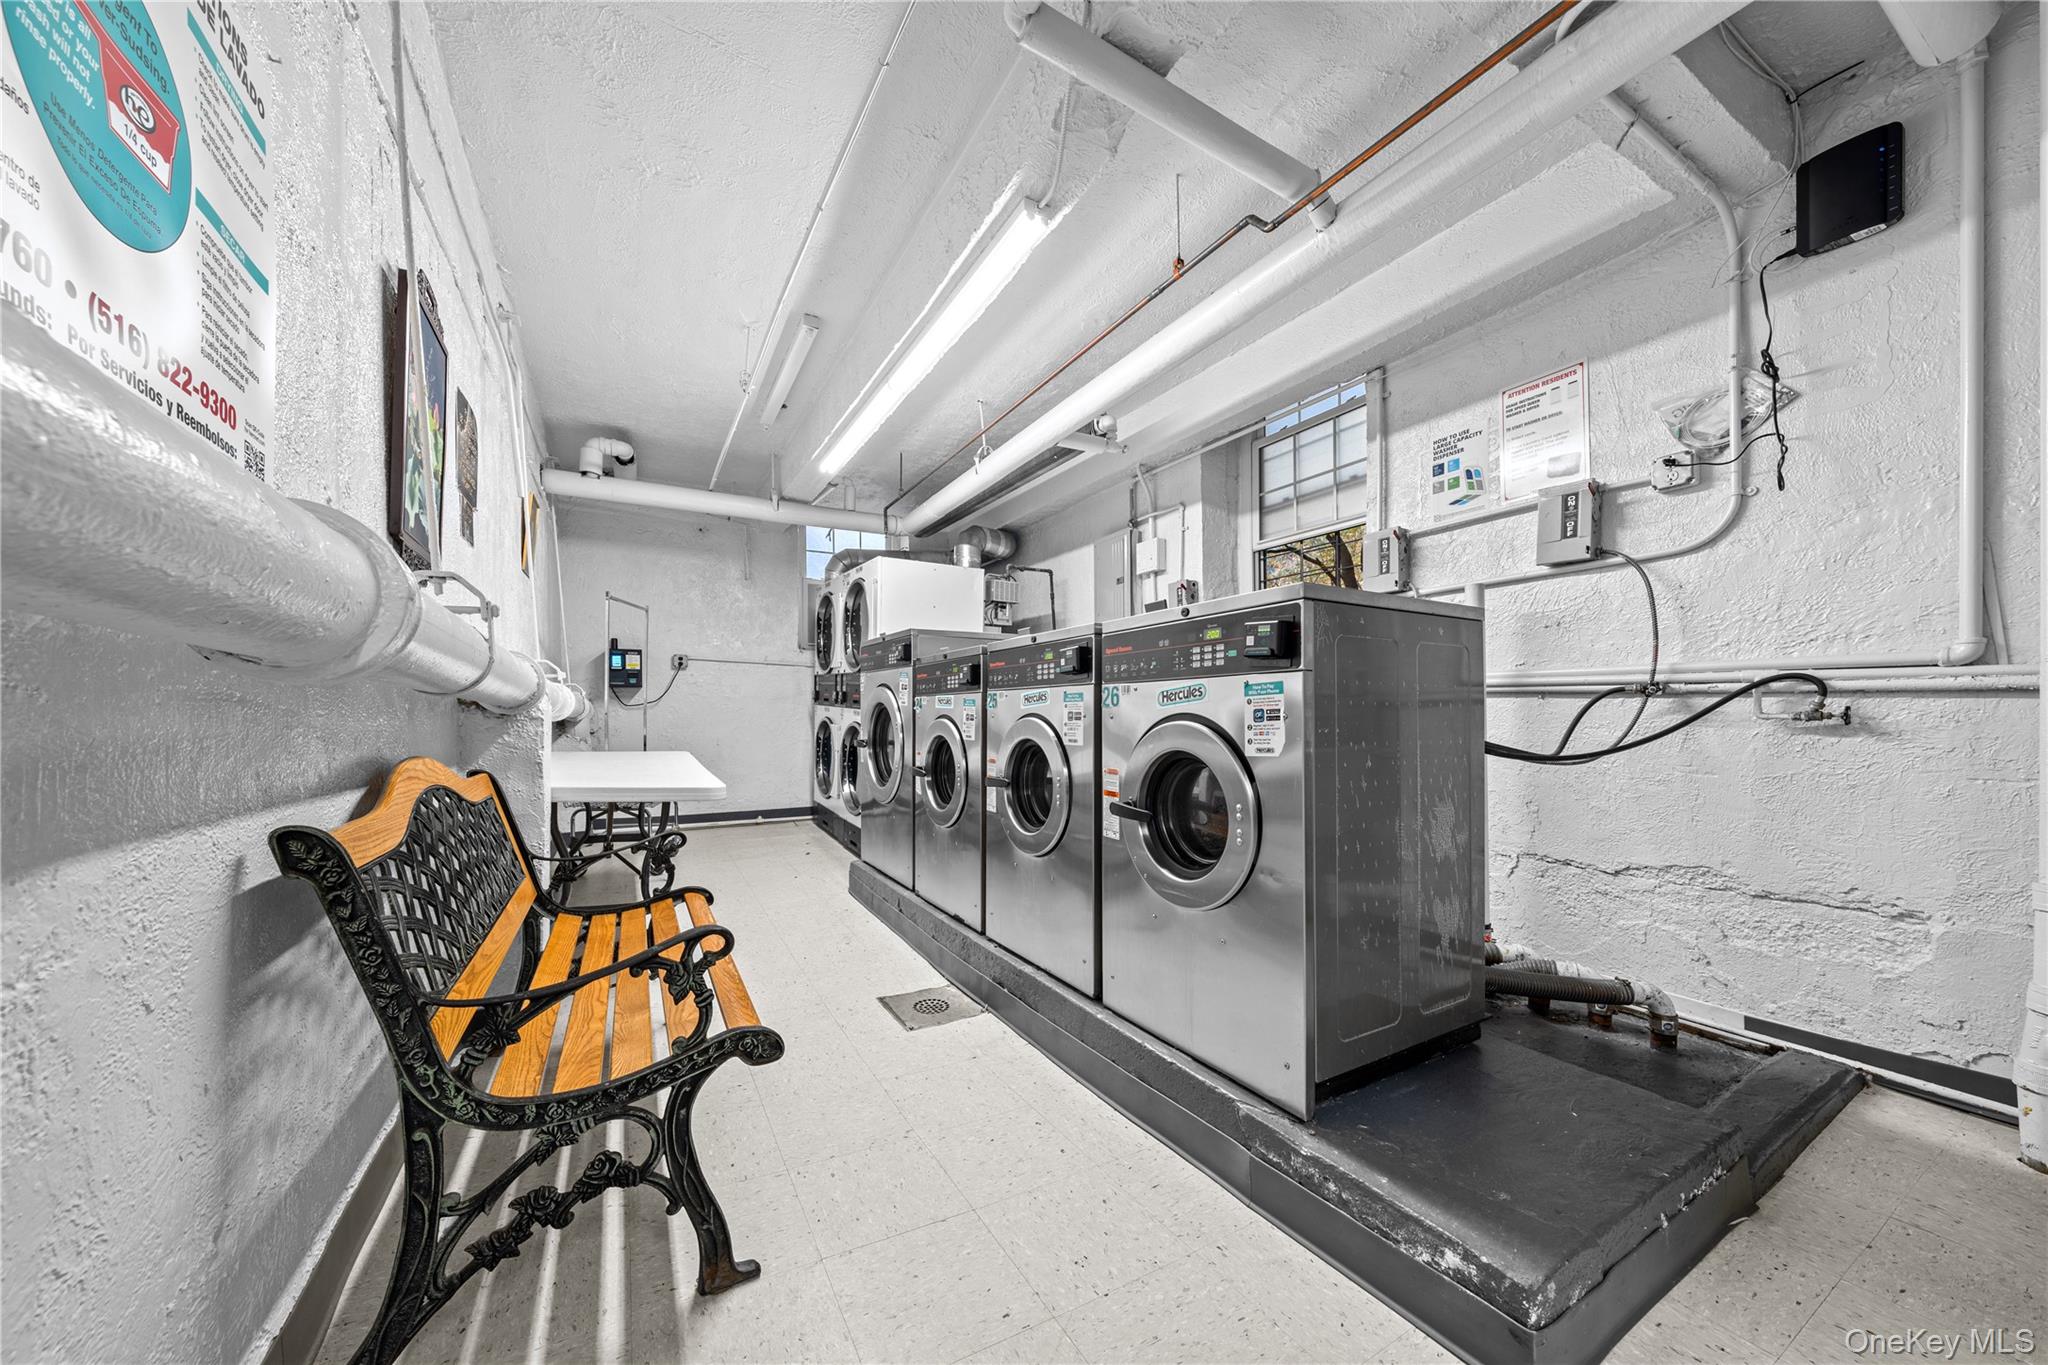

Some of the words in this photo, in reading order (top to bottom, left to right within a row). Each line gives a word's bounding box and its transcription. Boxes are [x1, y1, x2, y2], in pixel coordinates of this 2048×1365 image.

[65, 1, 76, 22] is
[77, 20, 92, 41] all
[15, 5, 48, 49] rinse
[48, 46, 96, 110] properly.
[52, 29, 71, 58] will
[72, 55, 91, 83] not
[62, 20, 74, 38] or
[75, 37, 100, 72] your
[144, 28, 157, 56] To
[220, 26, 265, 119] LAVADO
[50, 91, 67, 119] Use
[69, 115, 95, 152] Menos
[97, 147, 139, 198] Detergente
[140, 192, 158, 218] Para
[123, 123, 138, 147] 1/4
[140, 141, 157, 168] cup
[28, 175, 40, 194] de
[43, 101, 77, 146] Prevenir
[78, 143, 87, 159] El
[89, 156, 118, 191] Exceso
[120, 186, 131, 203] De
[133, 199, 162, 234] Espuma
[5, 172, 40, 211] lavado
[220, 224, 246, 264] SECAR
[89, 291, 149, 370] (516)
[157, 346, 237, 431] 822-9300
[67, 324, 95, 361] Por
[100, 348, 162, 407] Servicios
[166, 400, 173, 418] y
[176, 402, 237, 460] Reembolsos:
[1507, 382, 1541, 399] ATTENTION
[1541, 368, 1578, 387] RESIDENTS
[1433, 437, 1449, 446] HOW
[1459, 428, 1470, 437] USE
[1433, 442, 1452, 451] LARGE
[1452, 429, 1483, 445] CAPACITY
[1433, 445, 1458, 456] WASHER
[1433, 447, 1465, 462] DISPENSER
[987, 693, 997, 709] 25
[1023, 690, 1048, 703] Hercules
[1103, 686, 1120, 708] 26
[1161, 685, 1203, 703] Hercules
